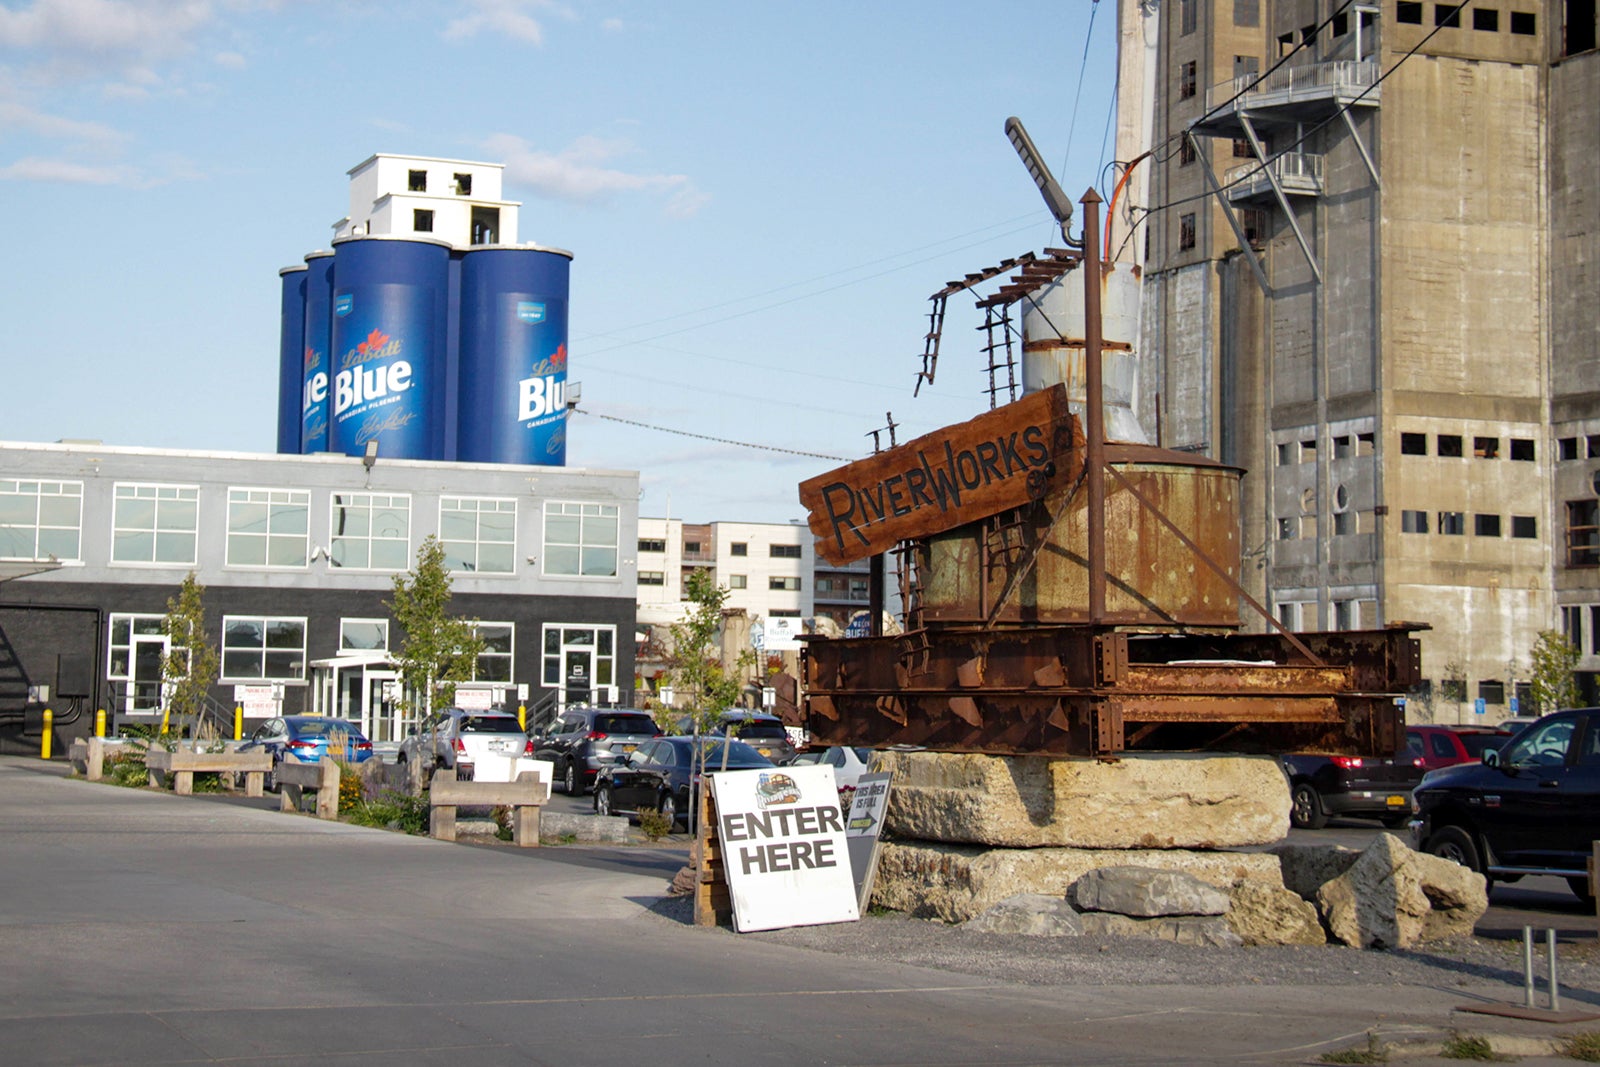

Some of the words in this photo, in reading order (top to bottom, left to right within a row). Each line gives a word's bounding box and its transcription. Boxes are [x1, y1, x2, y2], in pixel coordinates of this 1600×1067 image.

[341, 340, 403, 370] Labatt
[518, 375, 566, 422] Blu
[338, 405, 367, 423] CANADIAN
[854, 786, 870, 798] THIS
[869, 783, 886, 797] AREA
[855, 799, 864, 809] IS
[863, 796, 877, 808] FULL
[722, 805, 844, 842] ENTER
[739, 839, 837, 875] HERE
